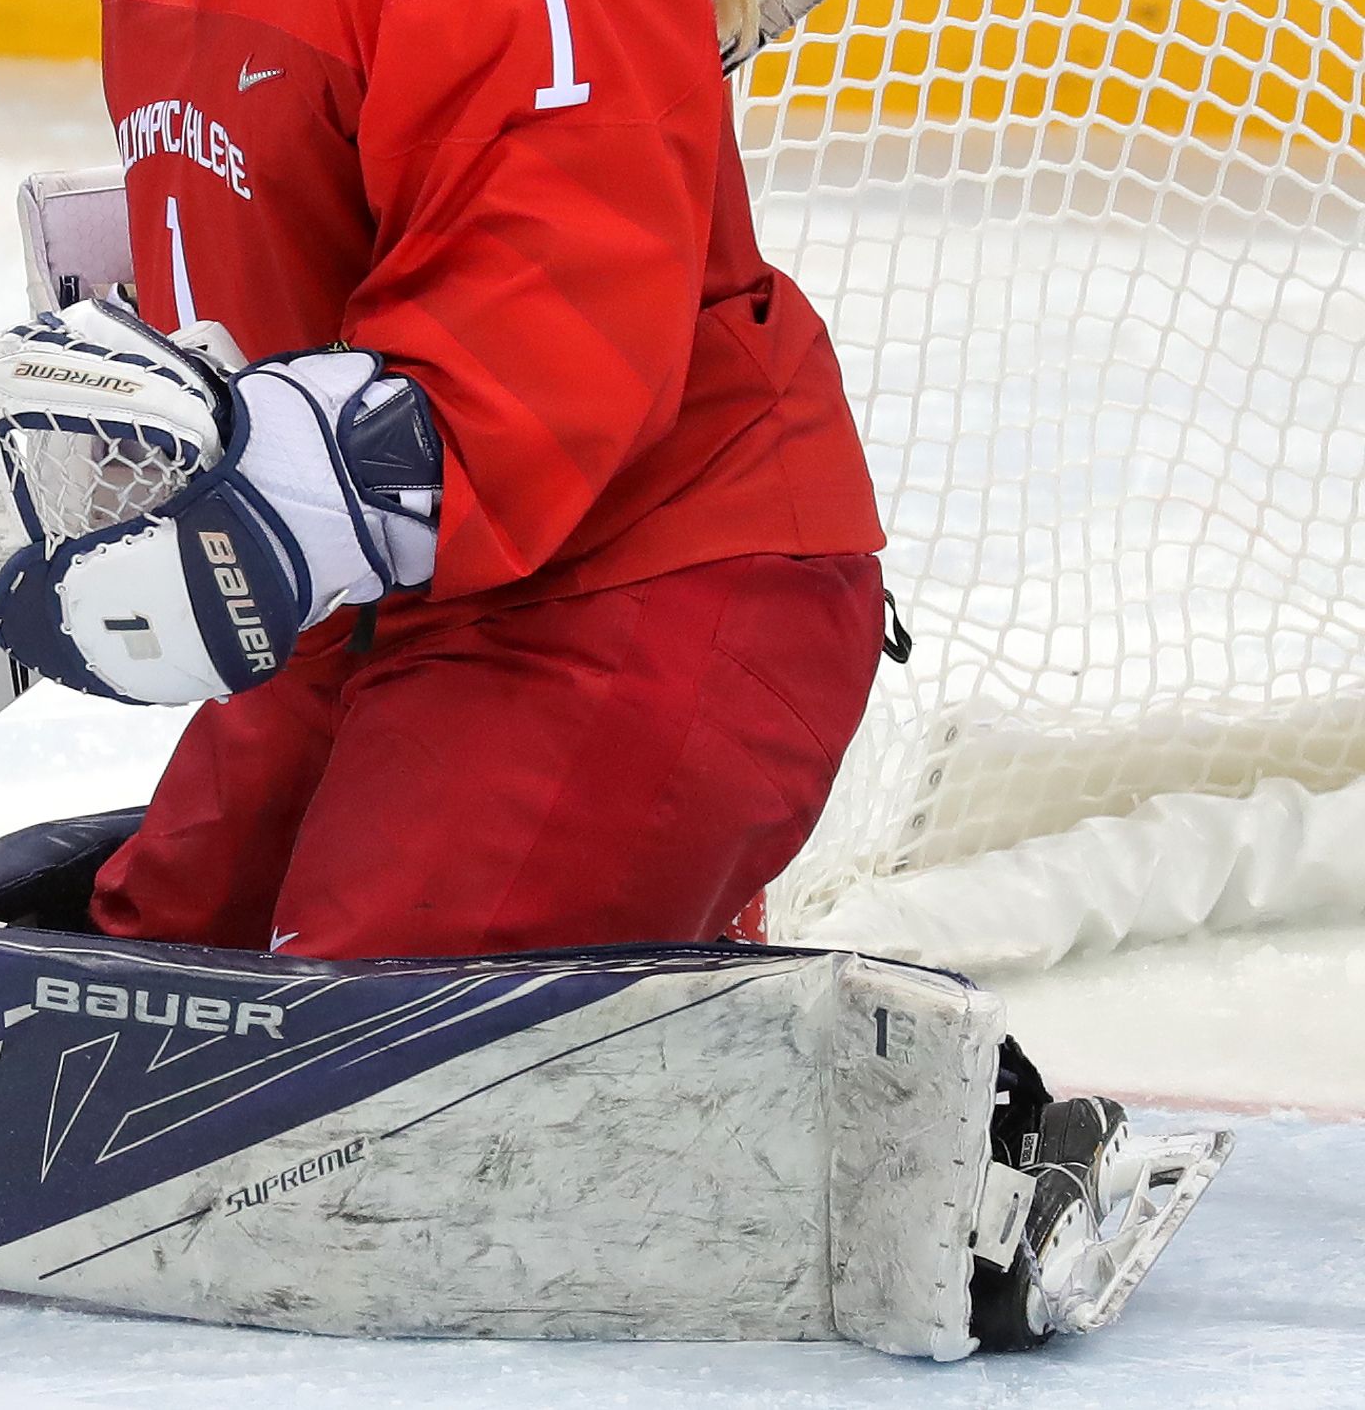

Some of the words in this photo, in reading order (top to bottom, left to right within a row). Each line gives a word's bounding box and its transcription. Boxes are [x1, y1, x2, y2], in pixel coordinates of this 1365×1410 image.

[118, 99, 181, 171] OLYMPIC
[12, 360, 145, 397] SUPREME
[198, 530, 277, 674] BAUER
[32, 975, 286, 1041] BAUER
[224, 1134, 367, 1218] SUPREME
